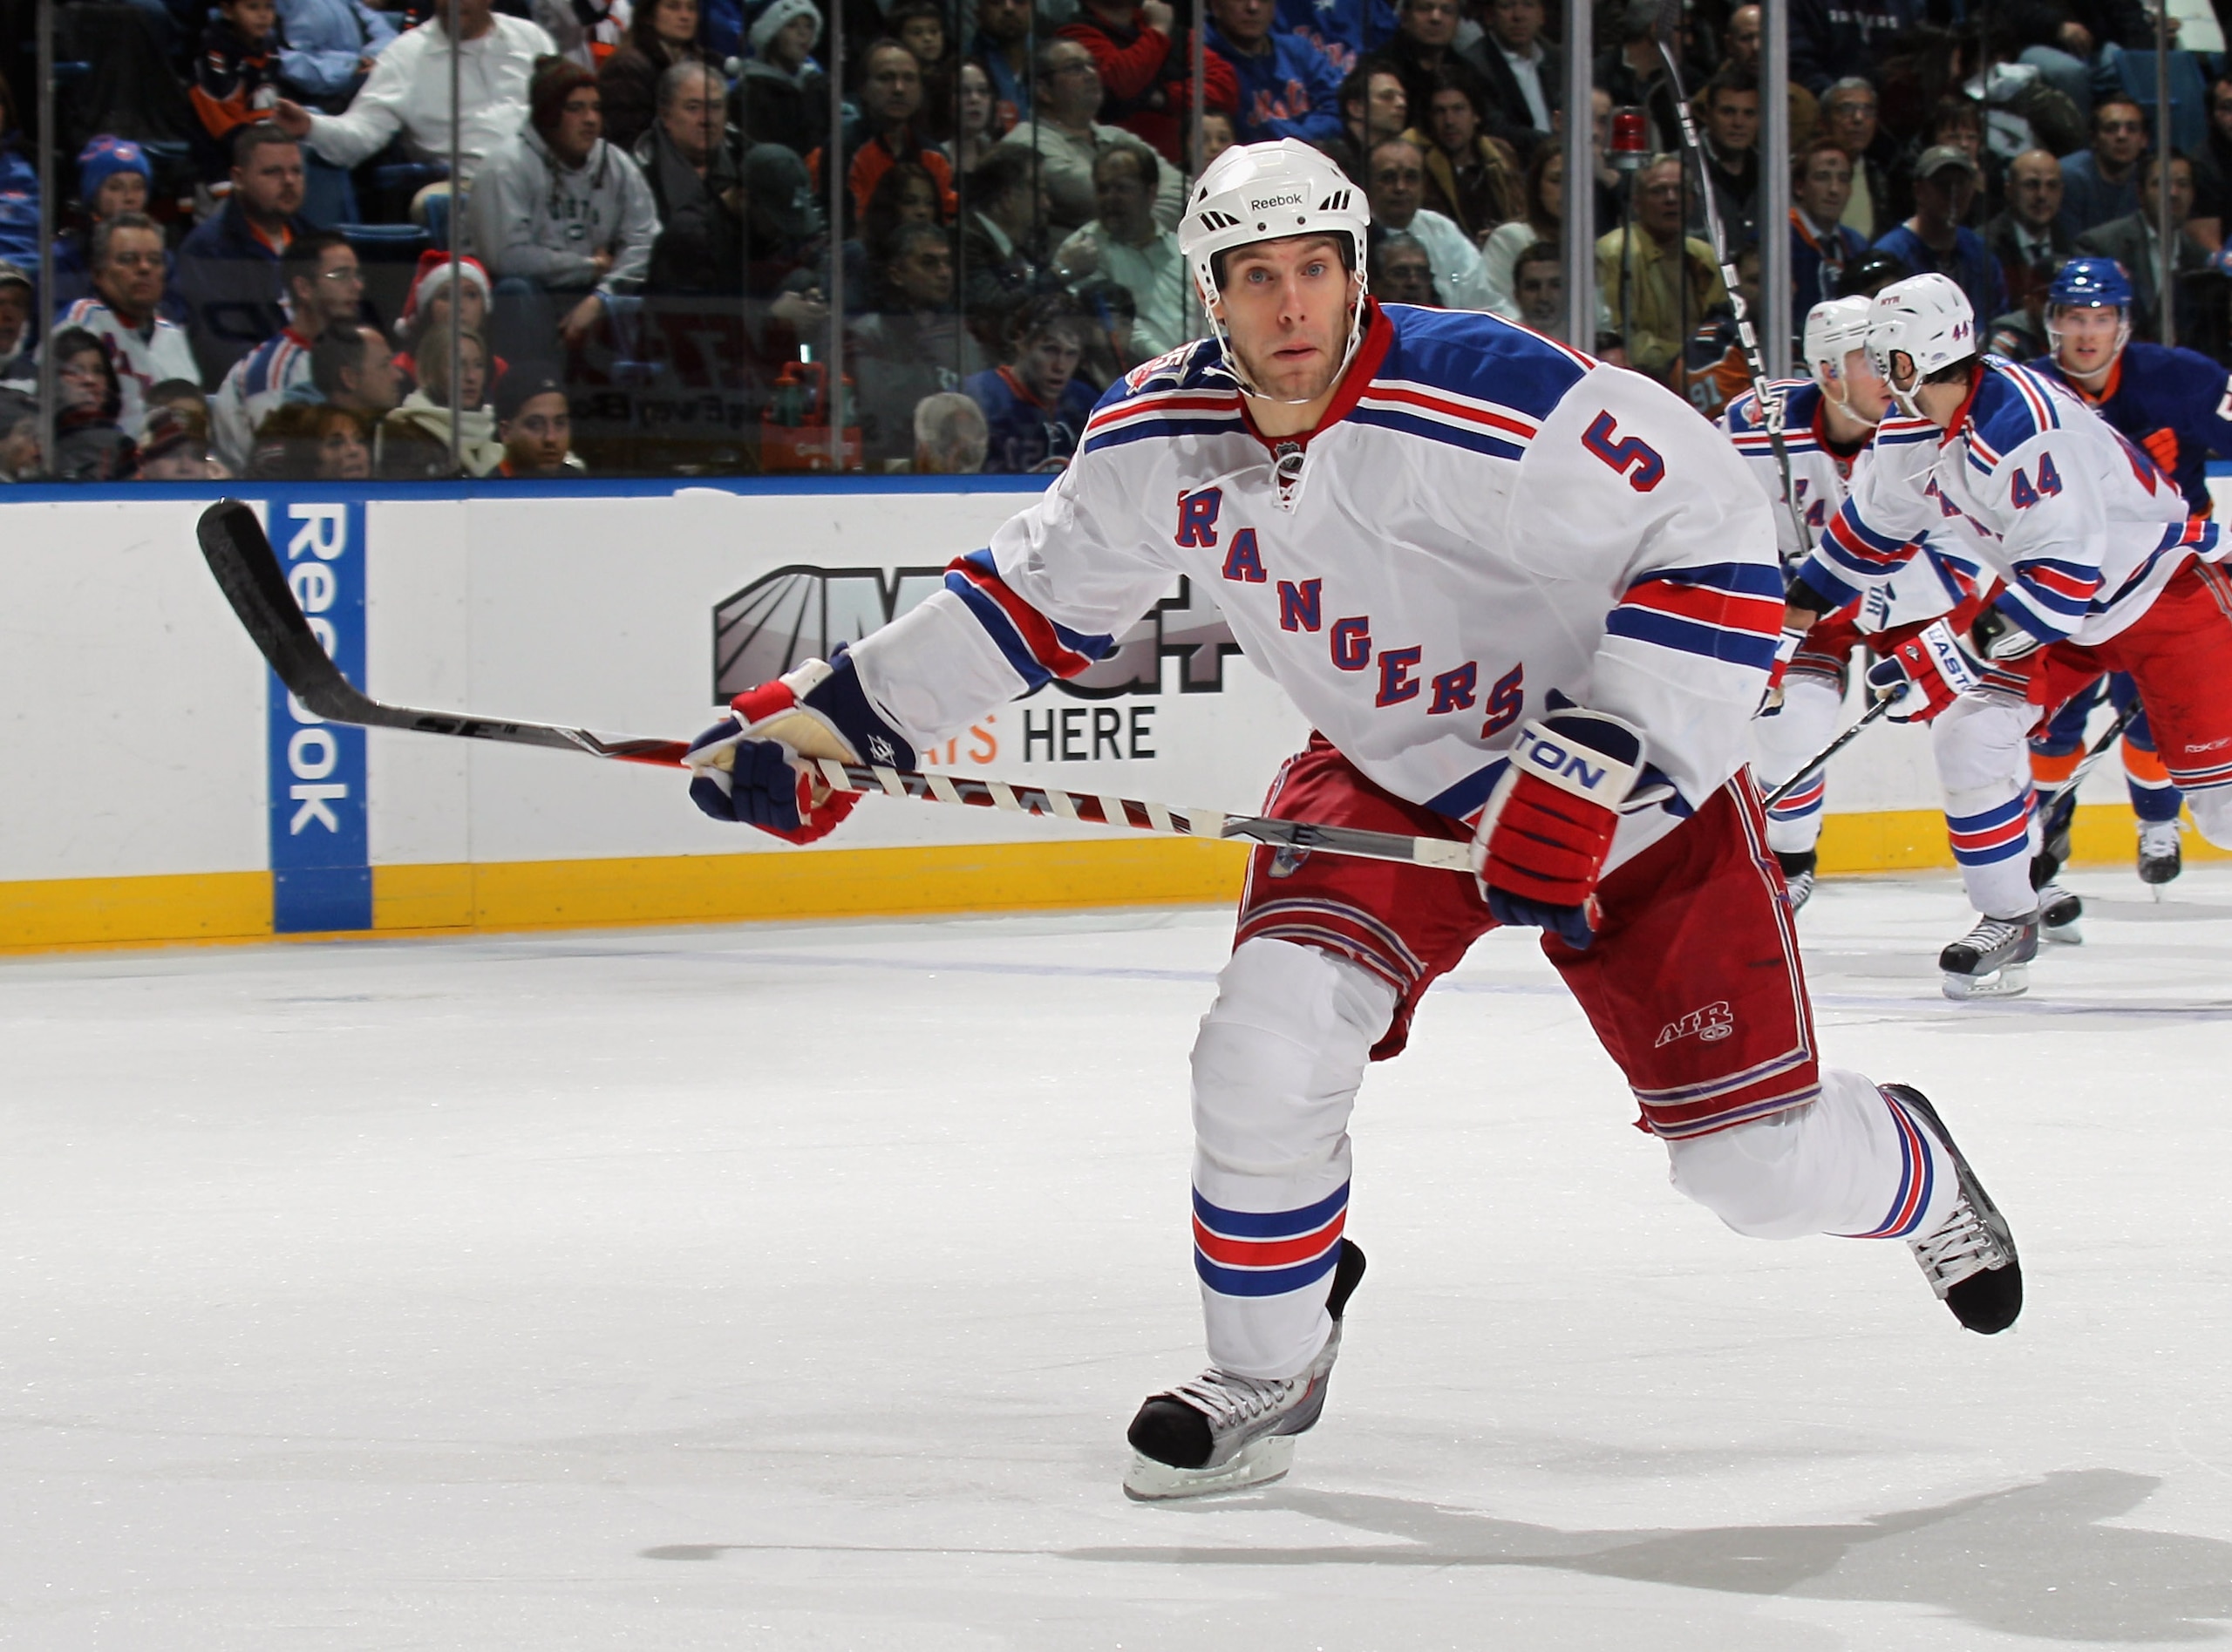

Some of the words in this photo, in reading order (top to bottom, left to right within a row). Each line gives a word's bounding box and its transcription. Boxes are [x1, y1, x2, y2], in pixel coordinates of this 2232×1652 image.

[1251, 194, 1303, 211] Reebok
[1880, 296, 1901, 306] NYR
[1952, 320, 1970, 342] 44
[1580, 409, 1665, 493] 5
[2011, 451, 2063, 509] 44
[1175, 486, 1524, 739] RANGERS
[287, 503, 348, 835] Reok
[1024, 706, 1157, 763] HERE
[1515, 729, 1606, 789] TON
